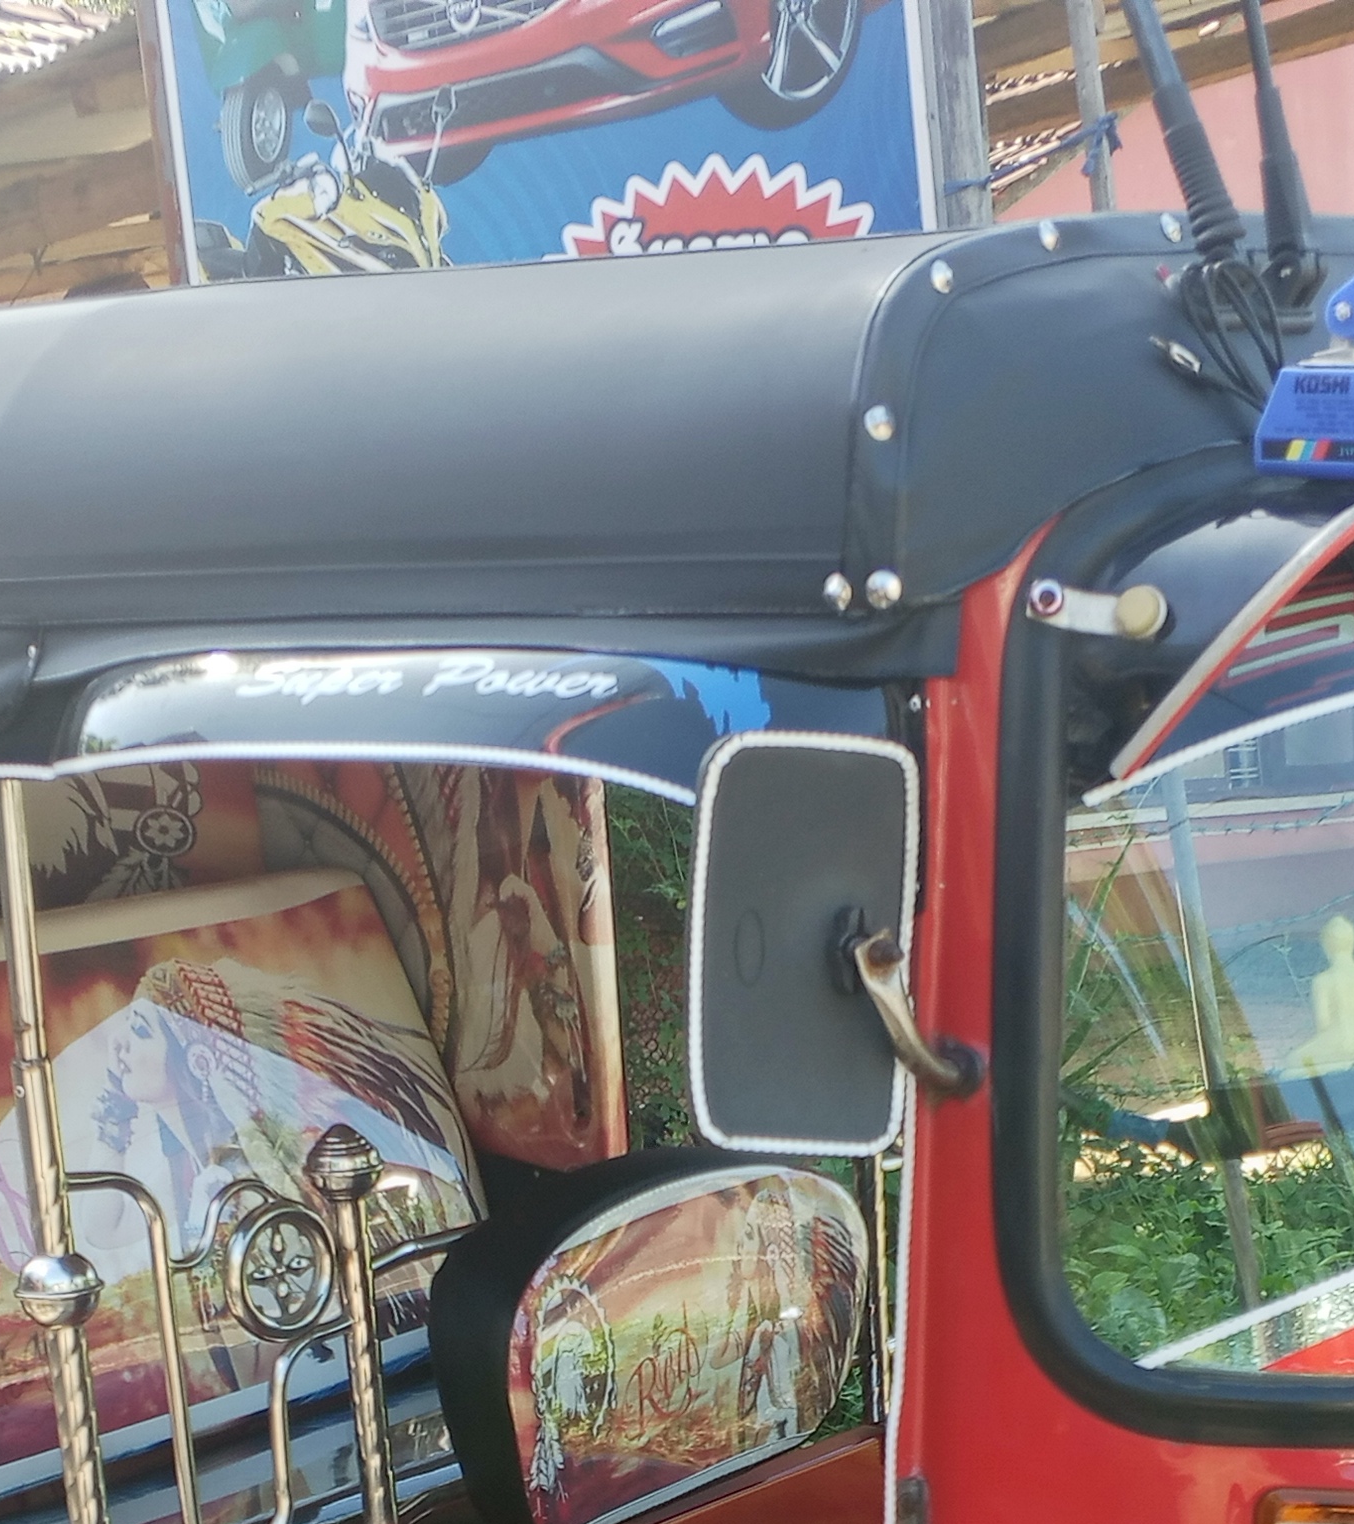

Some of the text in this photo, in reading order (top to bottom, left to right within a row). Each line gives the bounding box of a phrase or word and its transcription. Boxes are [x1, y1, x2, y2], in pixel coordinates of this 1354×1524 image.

[1293, 374, 1351, 395] KOSHI
[235, 656, 619, 706] Super Power
